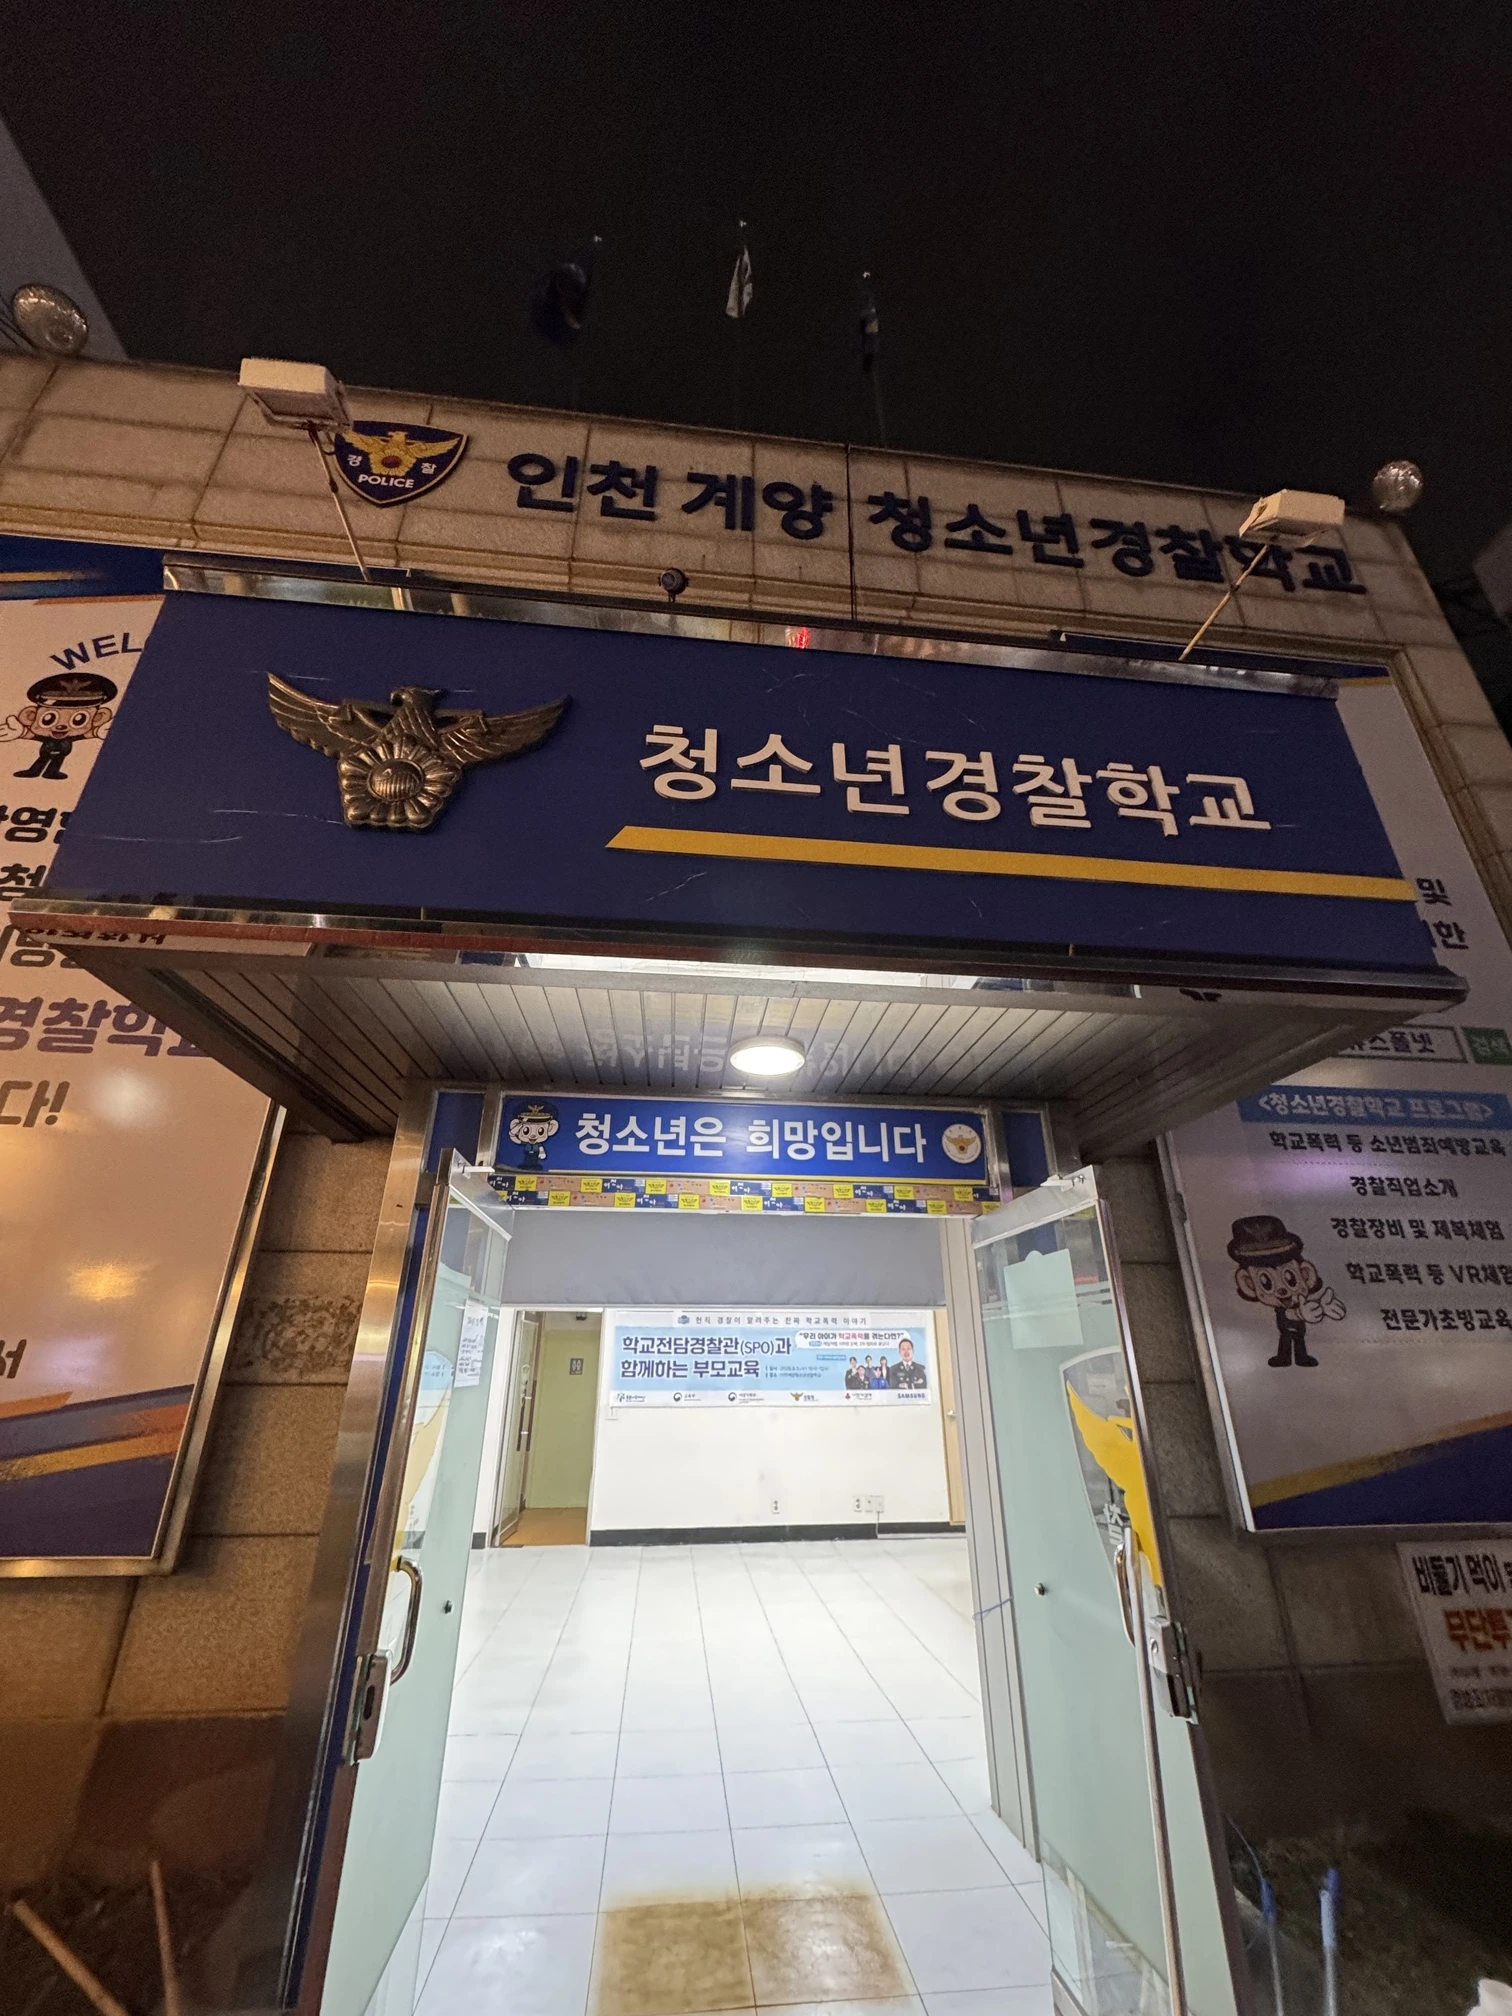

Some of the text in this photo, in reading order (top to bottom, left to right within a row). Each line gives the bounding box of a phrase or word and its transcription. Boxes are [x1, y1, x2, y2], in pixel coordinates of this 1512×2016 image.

[358, 474, 415, 489] POLICE
[506, 452, 1367, 595] 인천 계양 청소년경찰학교
[639, 724, 1272, 838] 청소년경찰학교
[1416, 878, 1453, 906] 및
[575, 1112, 927, 1164] 청소년은 희망입니다
[1269, 1130, 1507, 1157] 학교폭력 등 소년범죄예방교육
[1350, 1175, 1458, 1198] 경찰직업소개
[1330, 1217, 1505, 1241] 경찰장비 및 제복체험
[1345, 1262, 1423, 1285] 학교폭력
[1426, 1263, 1445, 1286] 등
[805, 1316, 838, 1326] 학교폭력
[843, 1317, 867, 1326] 이야기
[622, 1336, 792, 1356] 학교전담경찰관(SPO)과
[620, 1359, 760, 1379] 함께하는 부모교육
